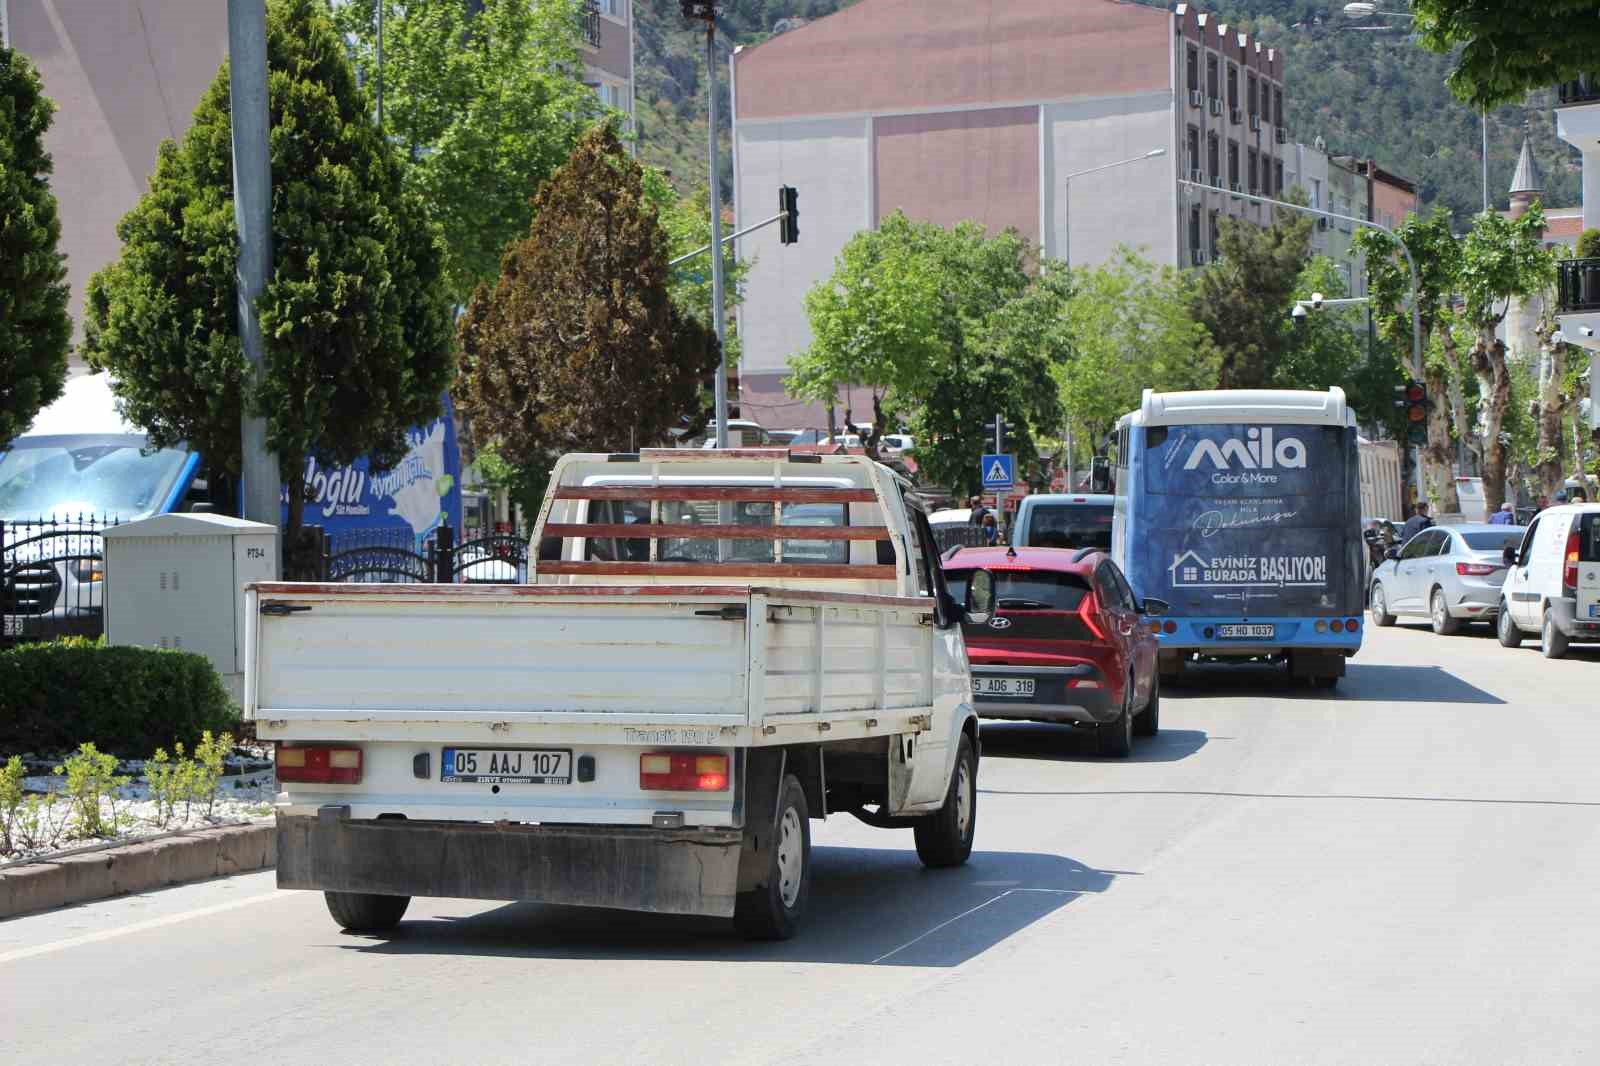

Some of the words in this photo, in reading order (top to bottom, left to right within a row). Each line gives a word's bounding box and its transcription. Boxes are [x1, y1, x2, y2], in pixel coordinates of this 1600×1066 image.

[1184, 427, 1307, 470] mila
[1211, 554, 1257, 569] EVİNİZ
[1260, 555, 1327, 587] BAŞLIYOR!
[1204, 569, 1257, 582] BURADA
[1015, 680, 1034, 693] 318
[455, 752, 478, 774] 05
[489, 753, 523, 774] AAJ
[532, 754, 562, 775] 107
